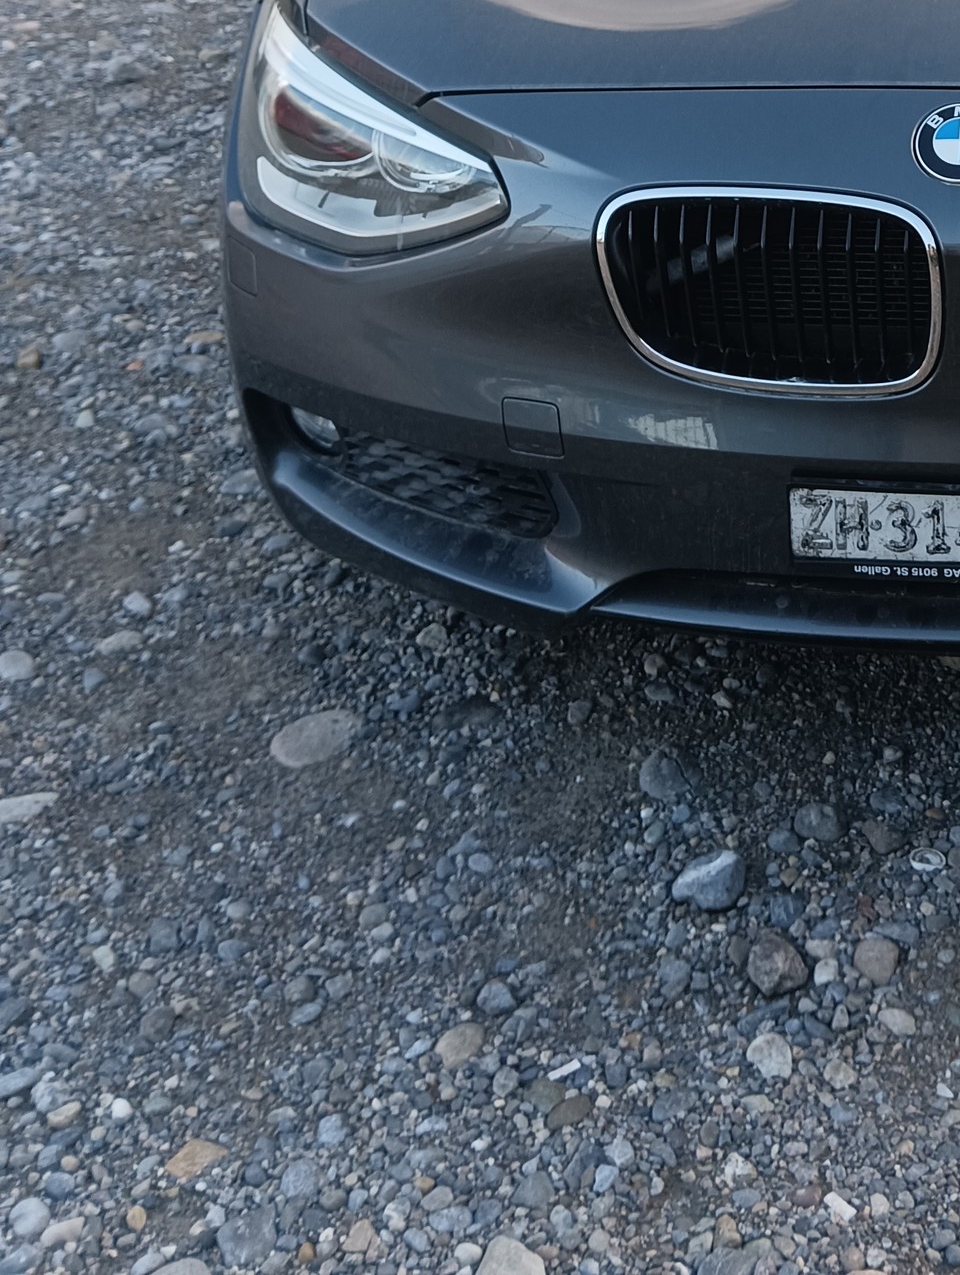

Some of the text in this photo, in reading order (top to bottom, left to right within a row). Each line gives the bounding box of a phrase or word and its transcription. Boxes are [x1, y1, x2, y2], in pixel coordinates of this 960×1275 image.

[853, 564, 891, 575] Gallen
[893, 566, 909, 576] St.
[911, 567, 938, 577] 9015
[944, 568, 960, 578] AG
